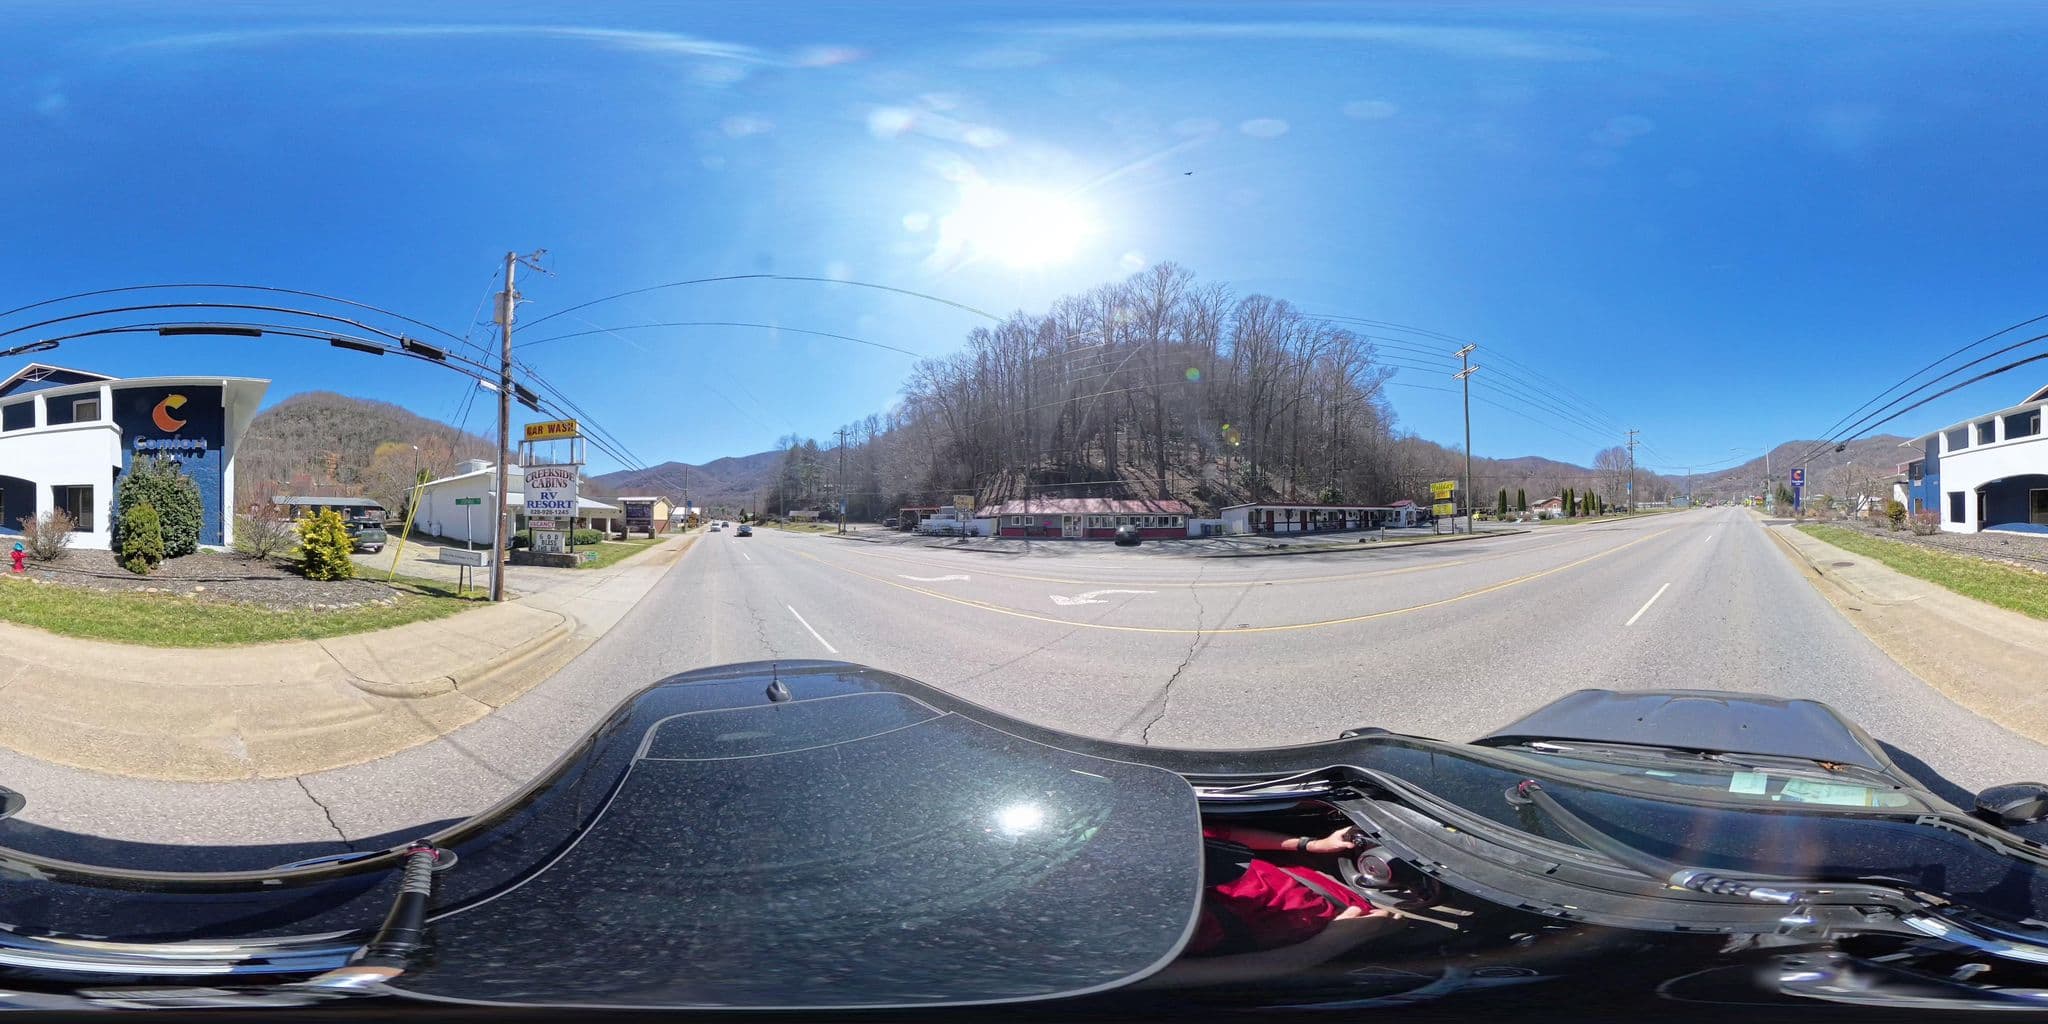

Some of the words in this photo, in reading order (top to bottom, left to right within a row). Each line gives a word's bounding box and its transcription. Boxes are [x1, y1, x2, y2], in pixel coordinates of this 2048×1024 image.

[527, 425, 543, 436] CAR
[548, 421, 574, 434] WASH
[133, 434, 207, 450] Comfort
[526, 468, 576, 483] CREEKSIDE
[532, 478, 568, 488] CABINS
[541, 492, 558, 500] RV
[527, 500, 574, 509] RESORT
